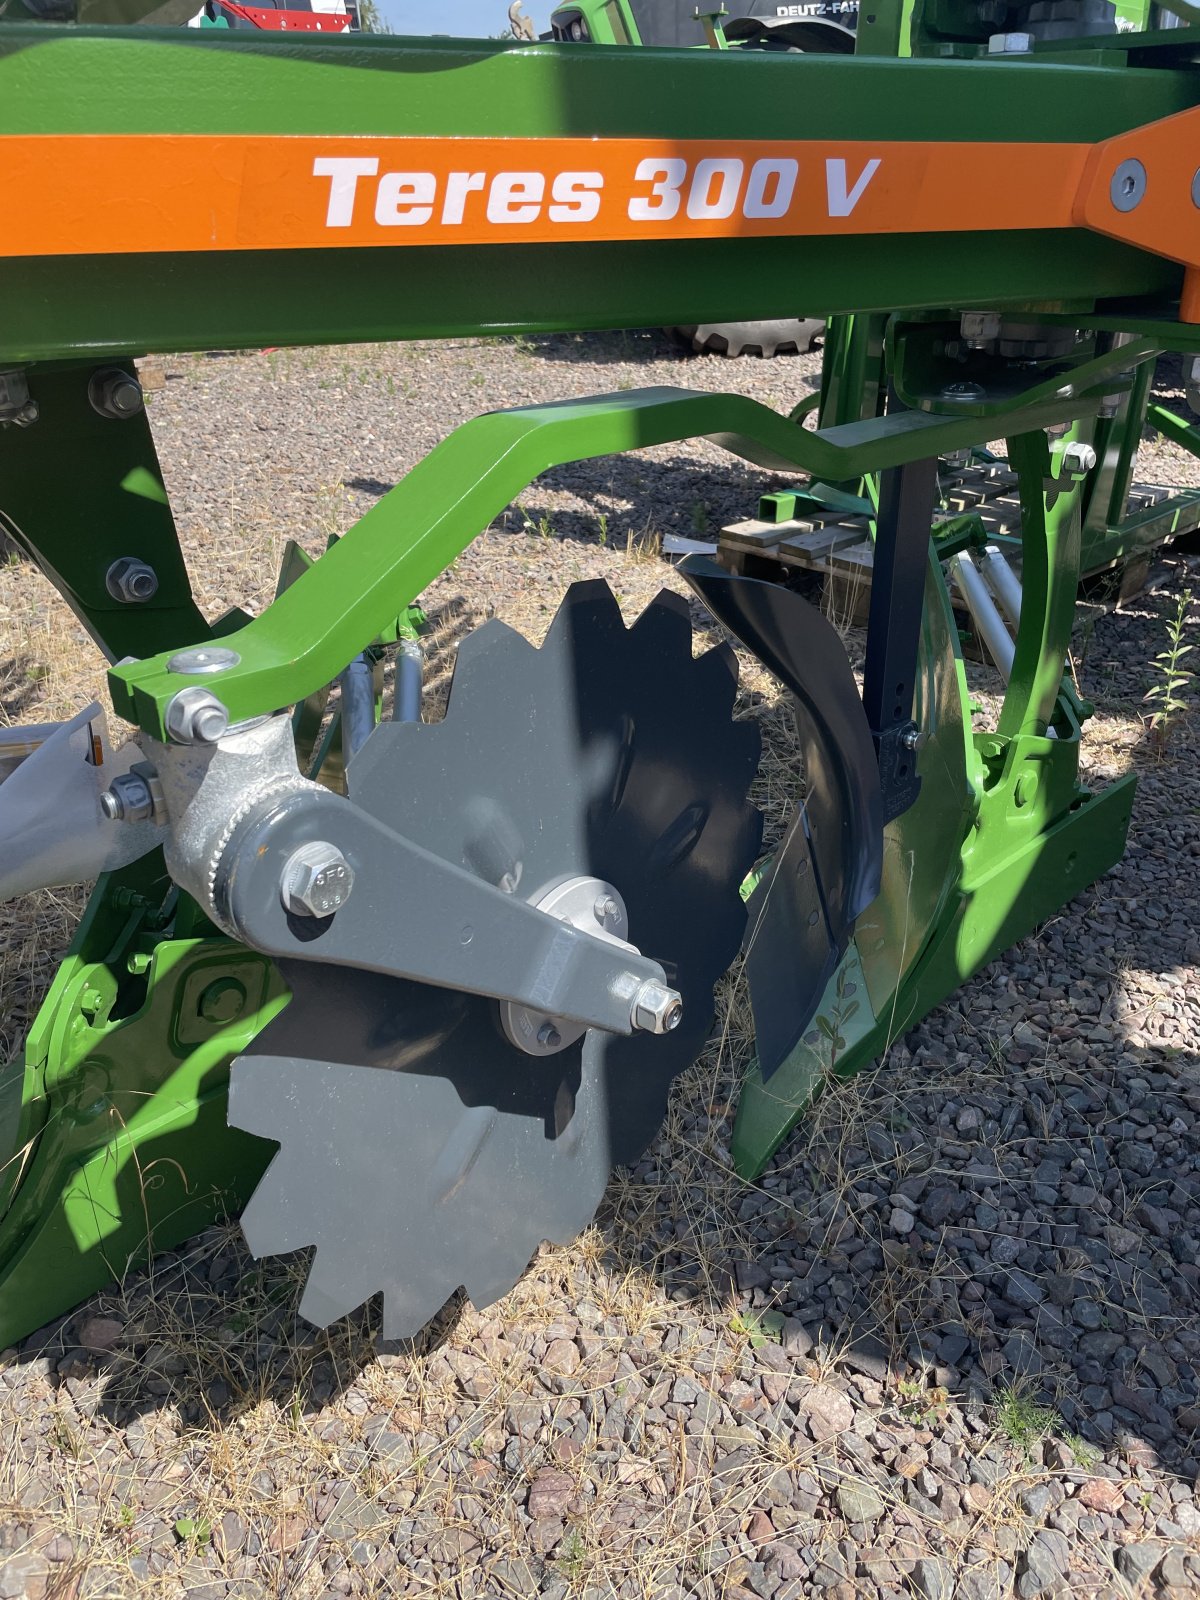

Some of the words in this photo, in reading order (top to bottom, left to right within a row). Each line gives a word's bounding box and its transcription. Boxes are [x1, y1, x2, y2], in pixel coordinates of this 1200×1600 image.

[312, 156, 605, 228] Teres
[627, 157, 799, 222] 300
[825, 158, 882, 217] V
